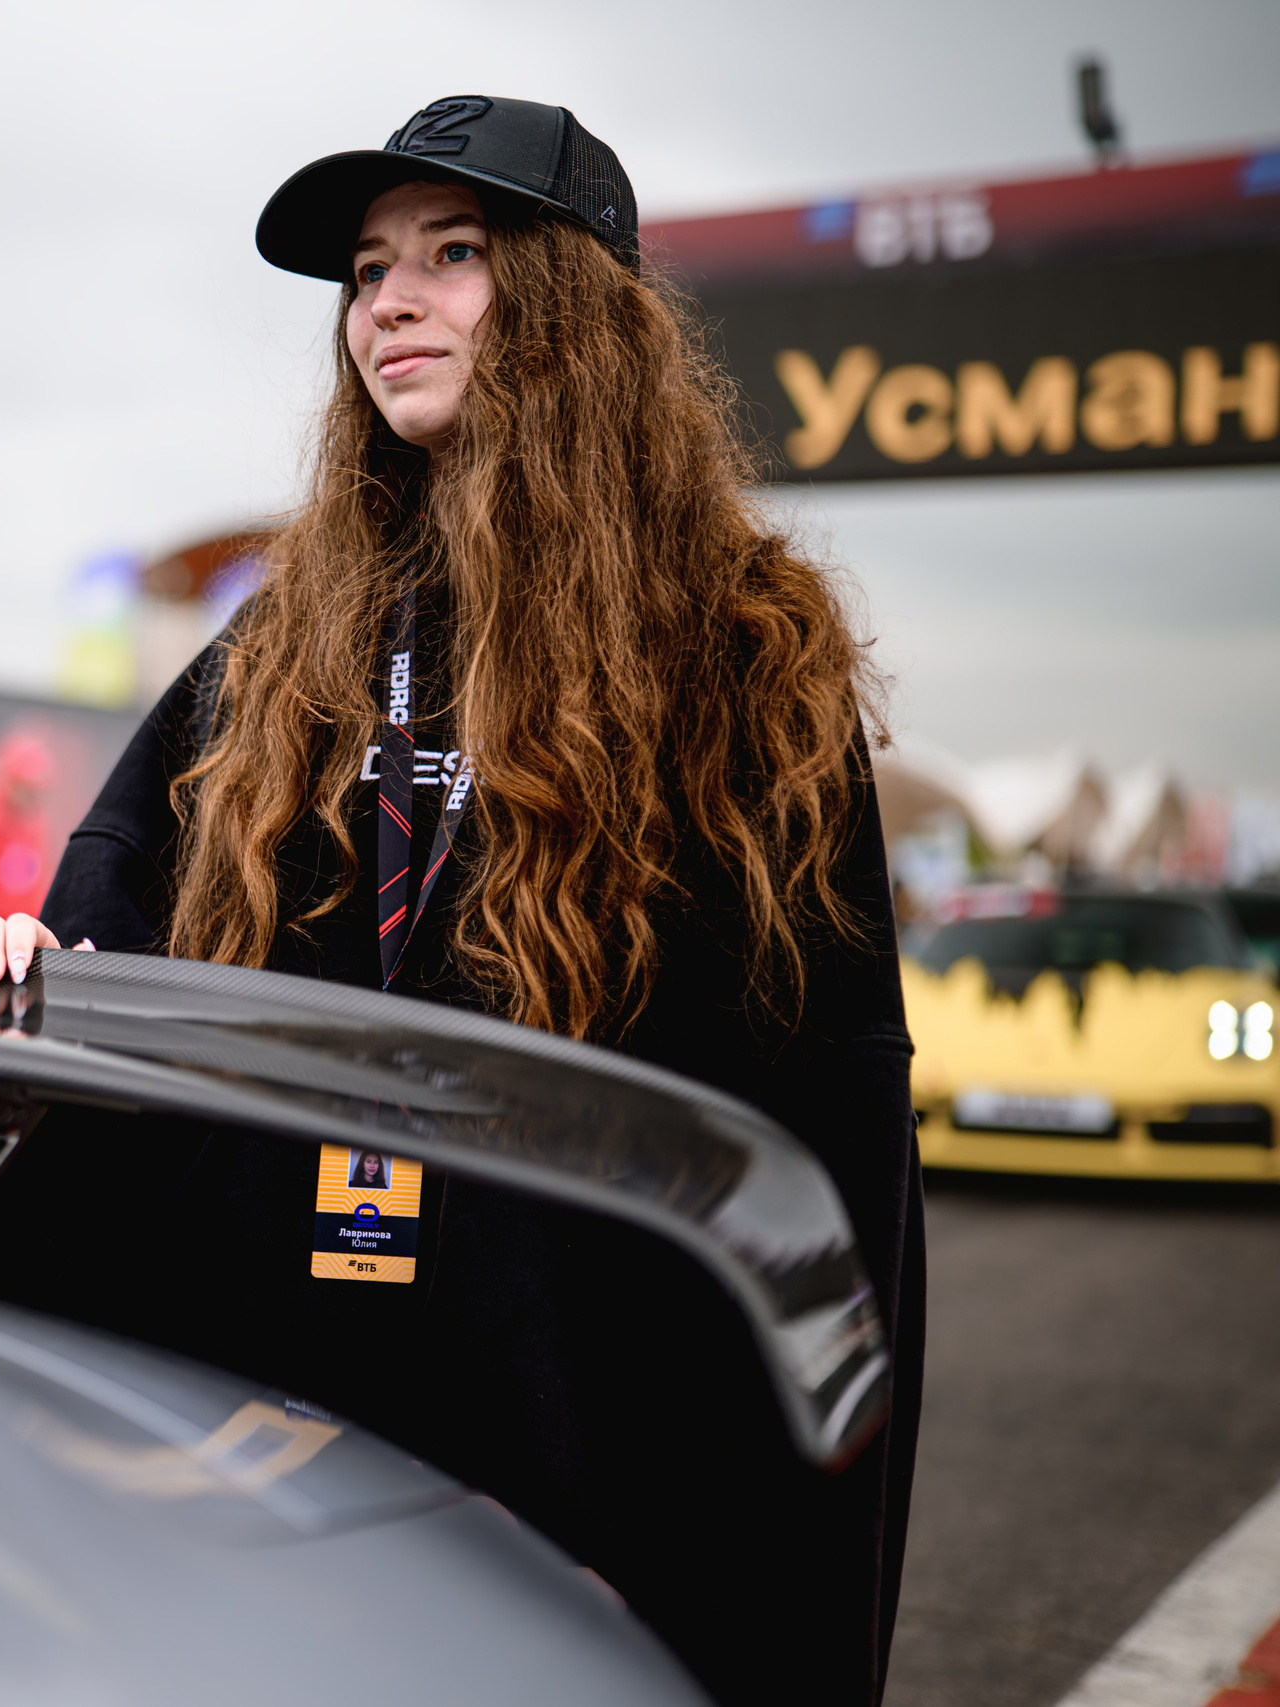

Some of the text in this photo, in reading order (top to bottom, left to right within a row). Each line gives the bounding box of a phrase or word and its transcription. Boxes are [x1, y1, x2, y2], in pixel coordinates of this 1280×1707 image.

[774, 342, 1280, 470] Усман
[389, 651, 410, 726] RDRC
[338, 1228, 392, 1239] Лавримова
[351, 1239, 378, 1249] Юлия
[357, 1263, 377, 1272] ВТБ
